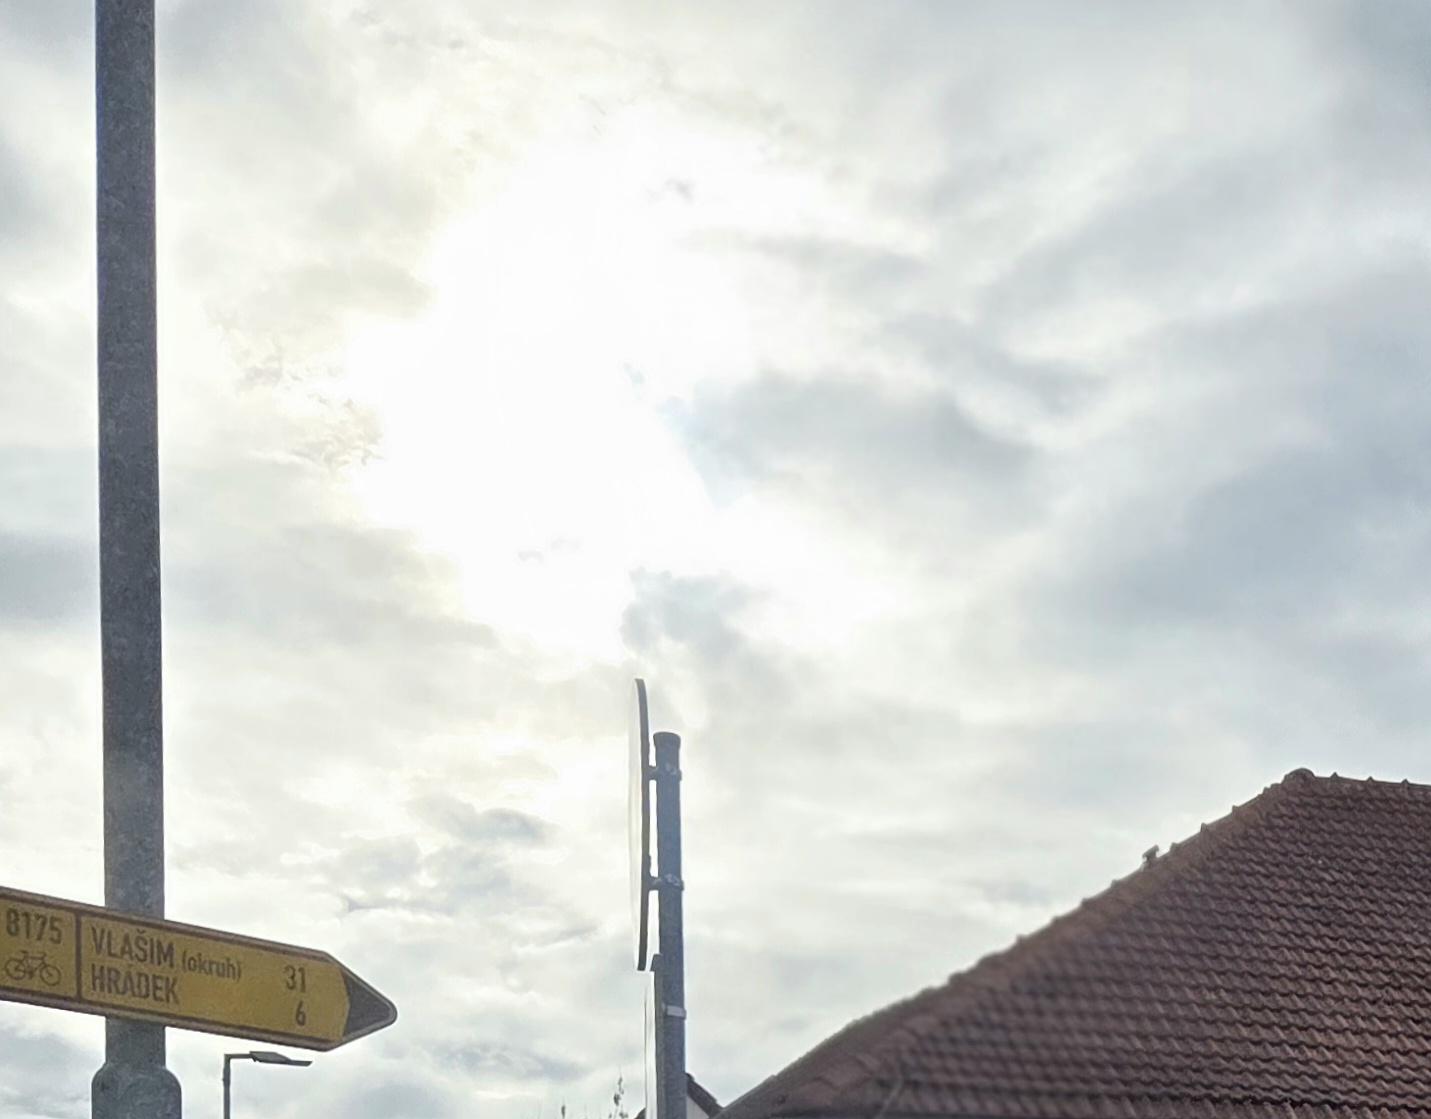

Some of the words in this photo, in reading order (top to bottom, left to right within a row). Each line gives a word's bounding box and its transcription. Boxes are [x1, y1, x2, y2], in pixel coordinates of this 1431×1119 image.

[6, 908, 62, 945] 8175
[91, 924, 175, 969] VLAŠIM
[181, 949, 242, 982] (okruh)
[284, 966, 307, 993] 31
[91, 962, 179, 1004] HRÁDEK
[295, 1001, 306, 1026] 6
